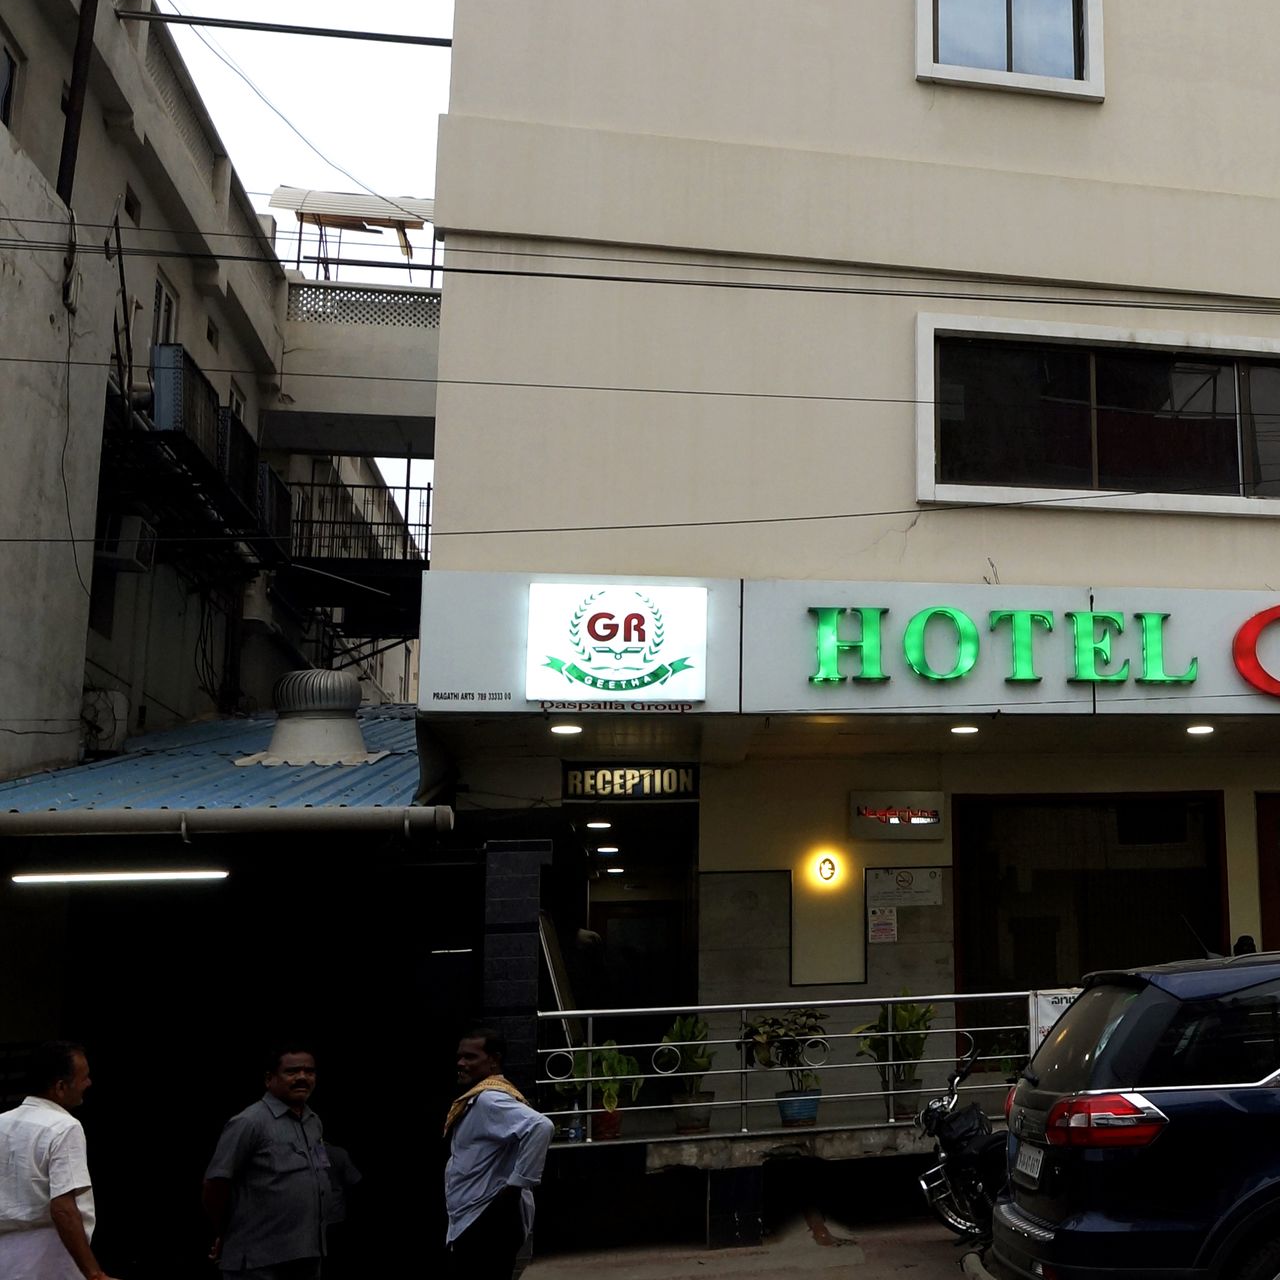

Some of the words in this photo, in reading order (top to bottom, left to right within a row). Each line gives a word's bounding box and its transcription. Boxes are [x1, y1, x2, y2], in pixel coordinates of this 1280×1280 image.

[587, 612, 646, 642] GR
[807, 605, 1197, 685] HOTEL
[584, 675, 652, 689] GEETHA
[433, 692, 460, 701] PRAGATHI
[460, 692, 475, 701] ARTS
[631, 701, 693, 714] Group
[567, 767, 694, 796] RECEPTION
